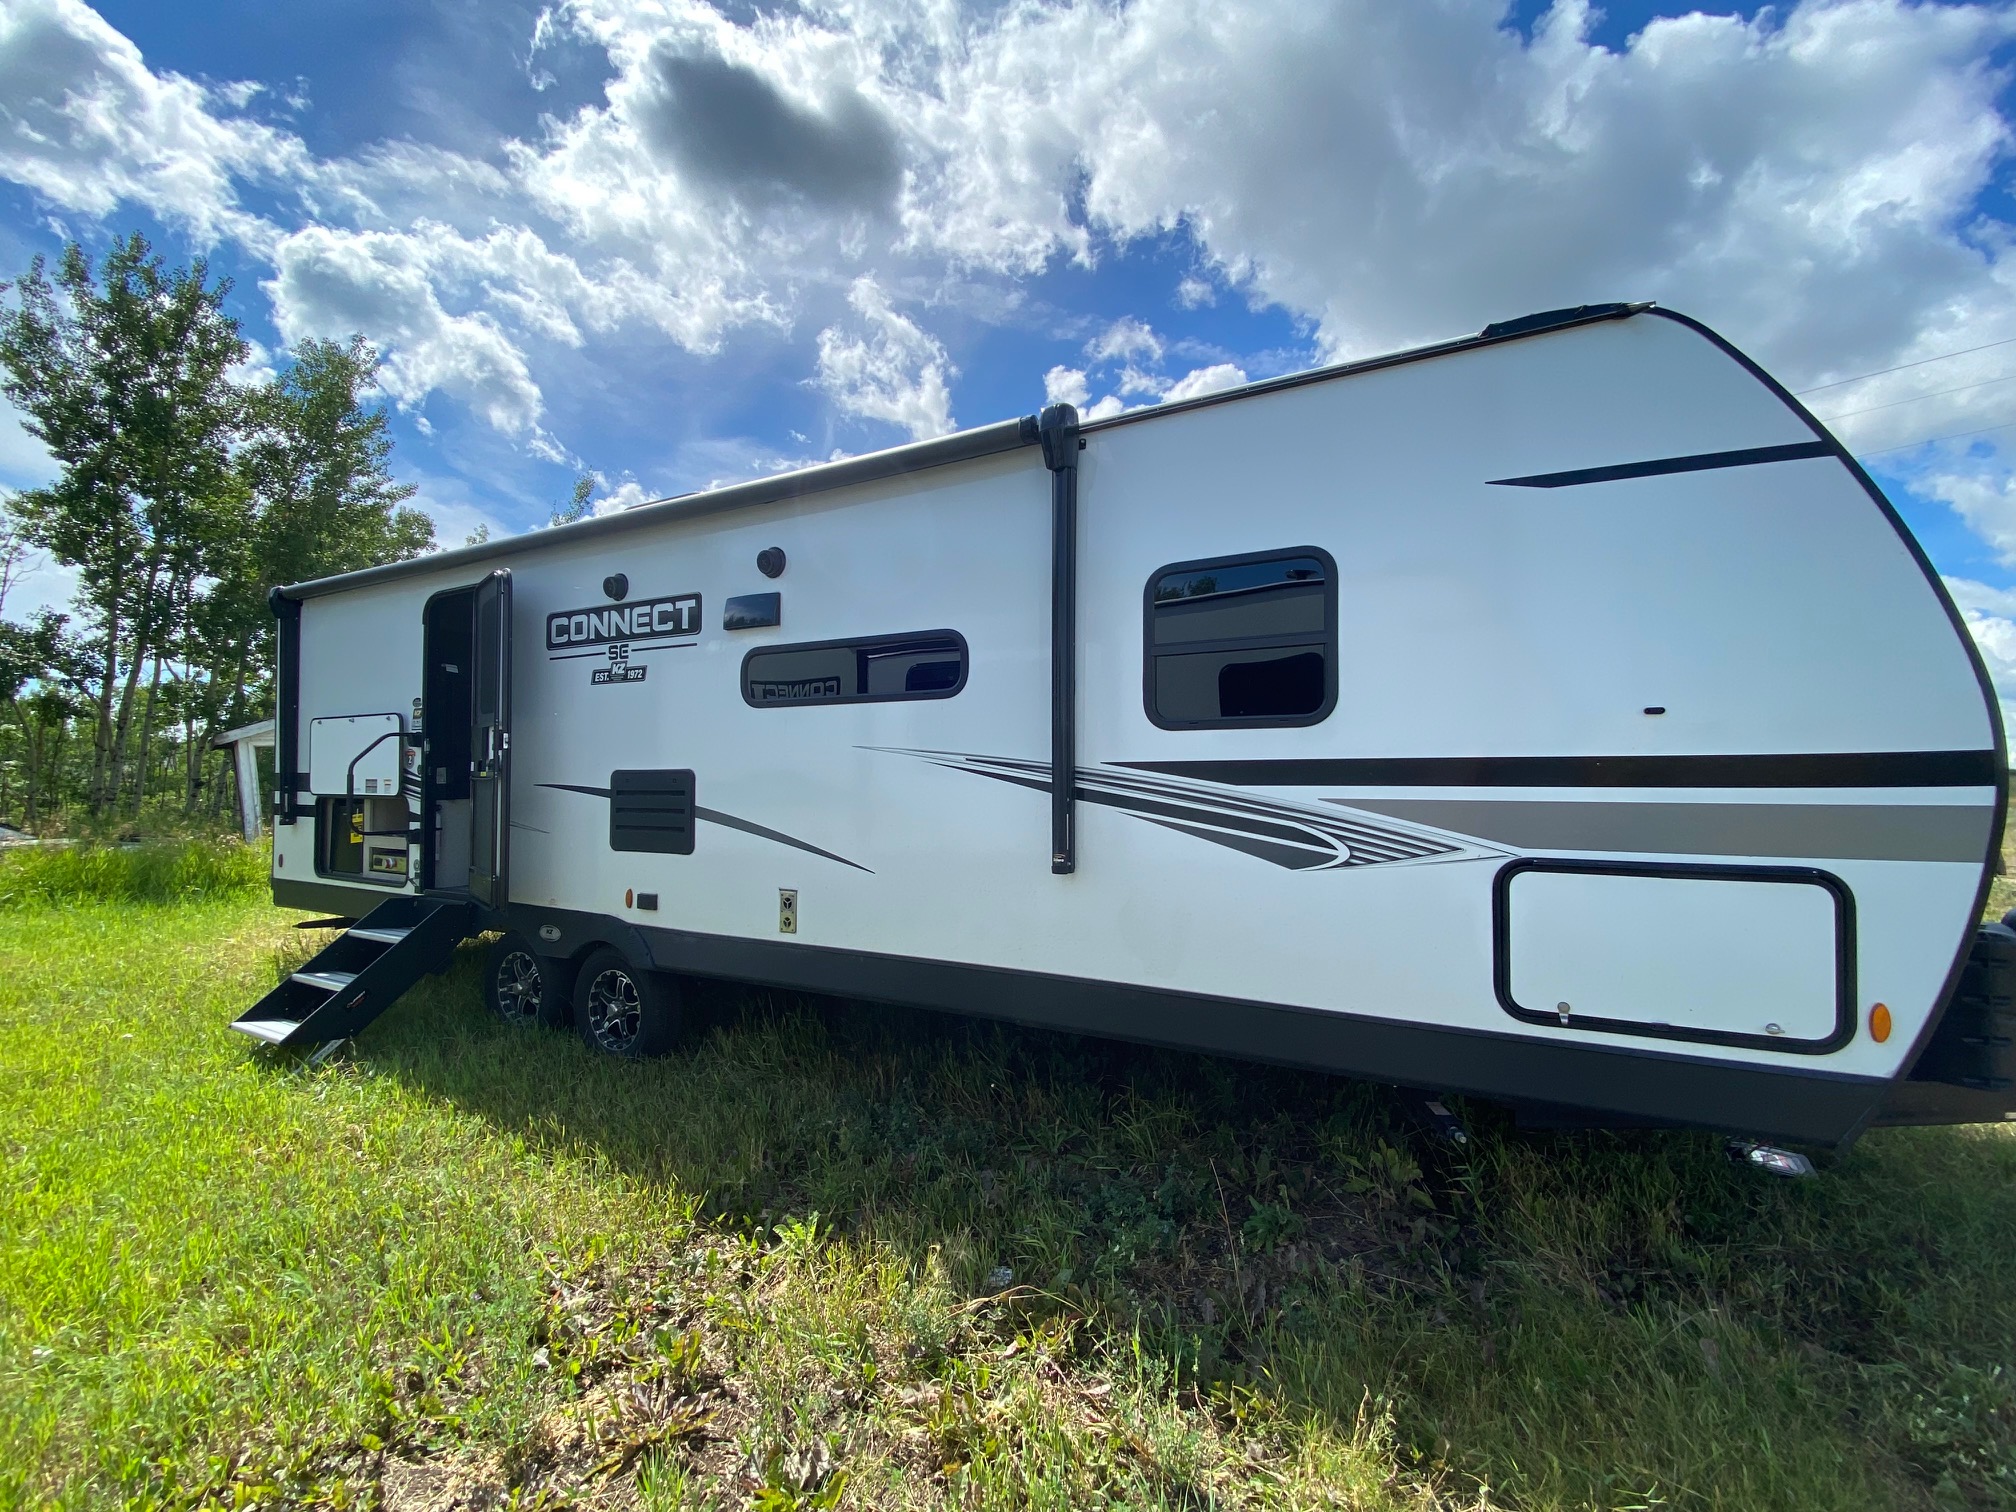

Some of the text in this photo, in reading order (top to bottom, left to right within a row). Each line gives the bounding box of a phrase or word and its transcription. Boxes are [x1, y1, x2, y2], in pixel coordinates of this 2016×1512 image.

[550, 599, 696, 644] CONNECT
[608, 643, 629, 661] SE
[595, 669, 643, 681] EST. 1972
[612, 663, 626, 674] KZ
